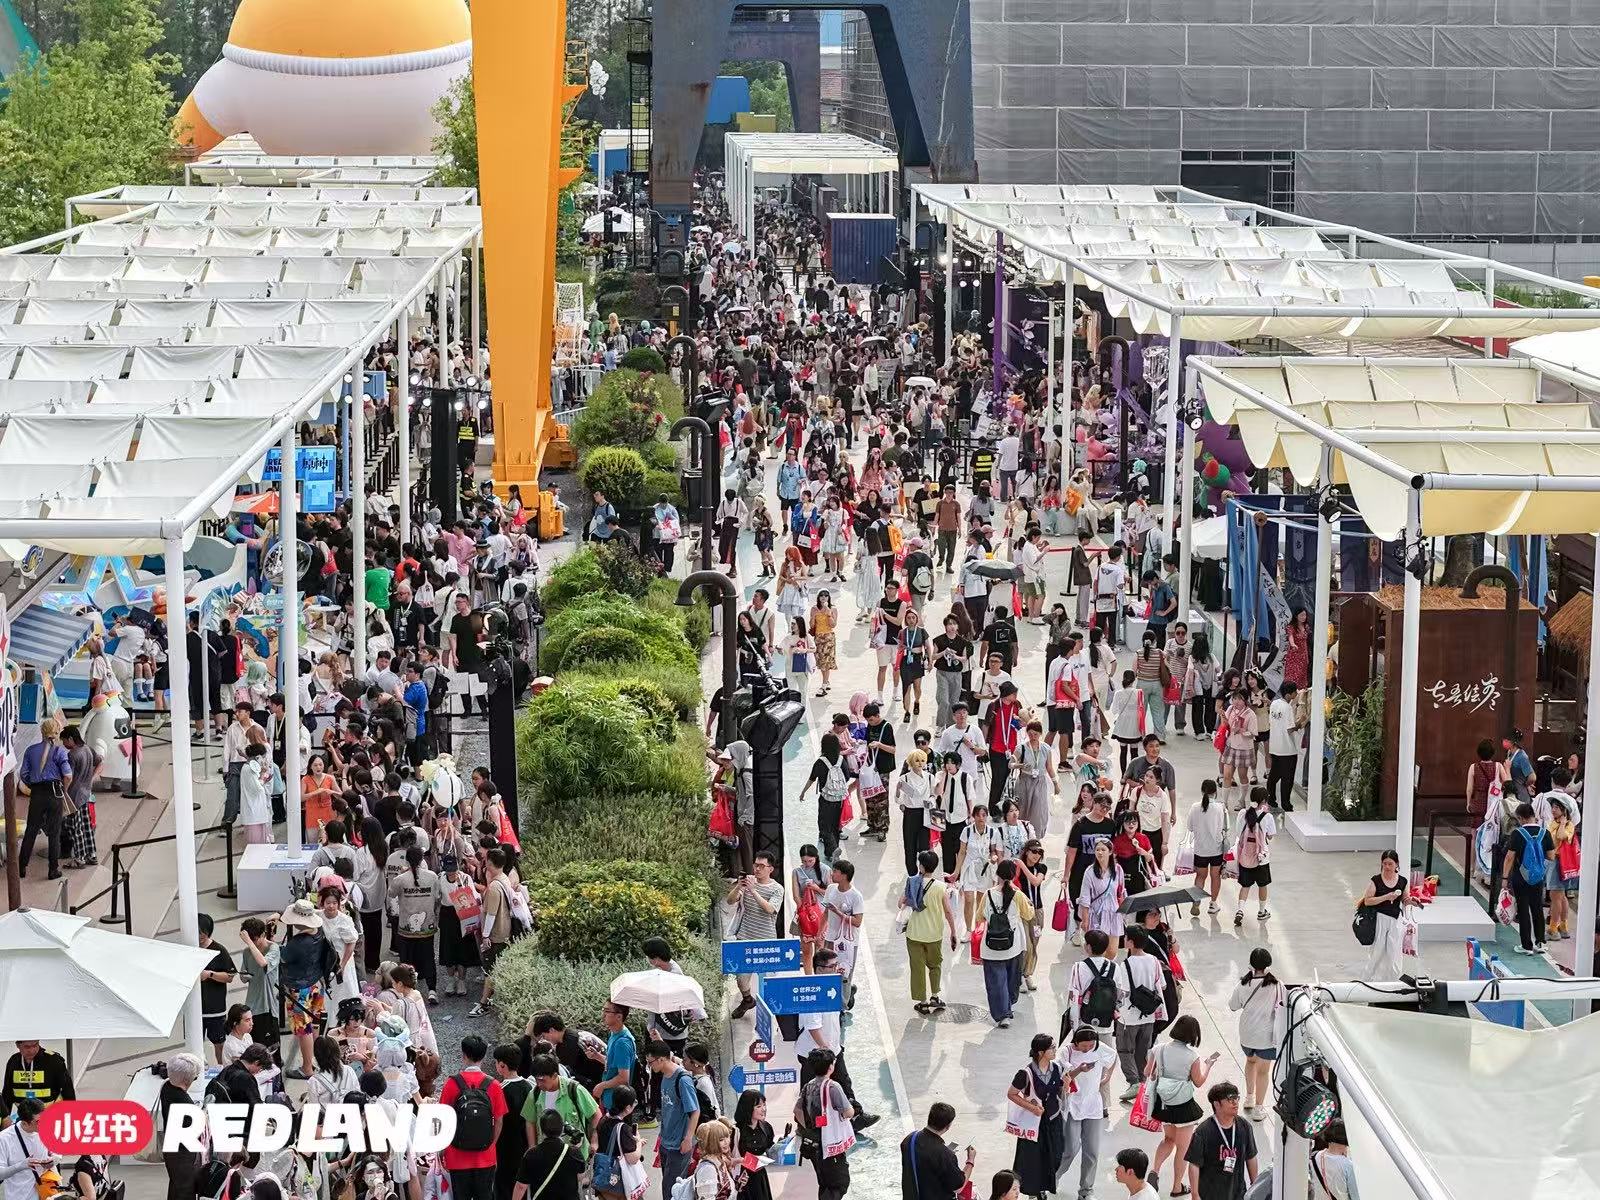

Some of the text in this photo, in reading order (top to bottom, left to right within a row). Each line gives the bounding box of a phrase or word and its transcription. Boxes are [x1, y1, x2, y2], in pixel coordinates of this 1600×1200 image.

[302, 454, 329, 475] 原神
[1424, 673, 1503, 713] 太吾绘卷
[745, 1072, 795, 1085] 逛展主动线
